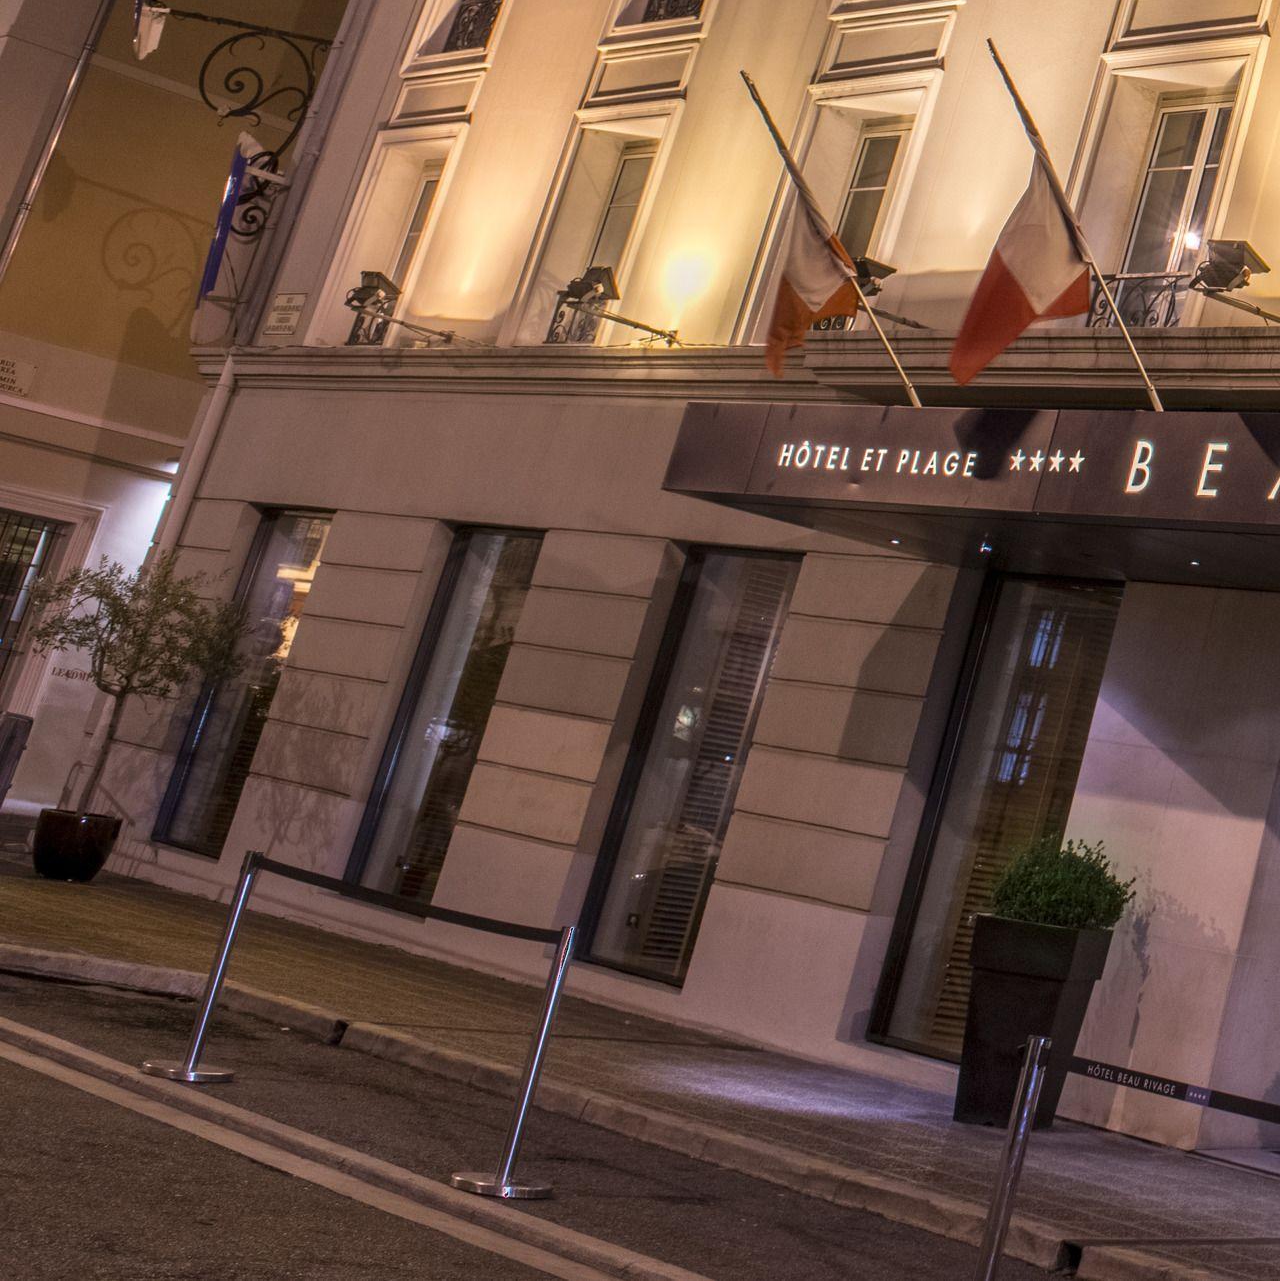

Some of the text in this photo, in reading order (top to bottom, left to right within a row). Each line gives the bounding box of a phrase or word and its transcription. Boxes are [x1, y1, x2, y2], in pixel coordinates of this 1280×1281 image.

[777, 440, 978, 477] HÔTEL ET PLAGE
[1087, 1064, 1177, 1096] HÔTEL BEAU RIVAGE
